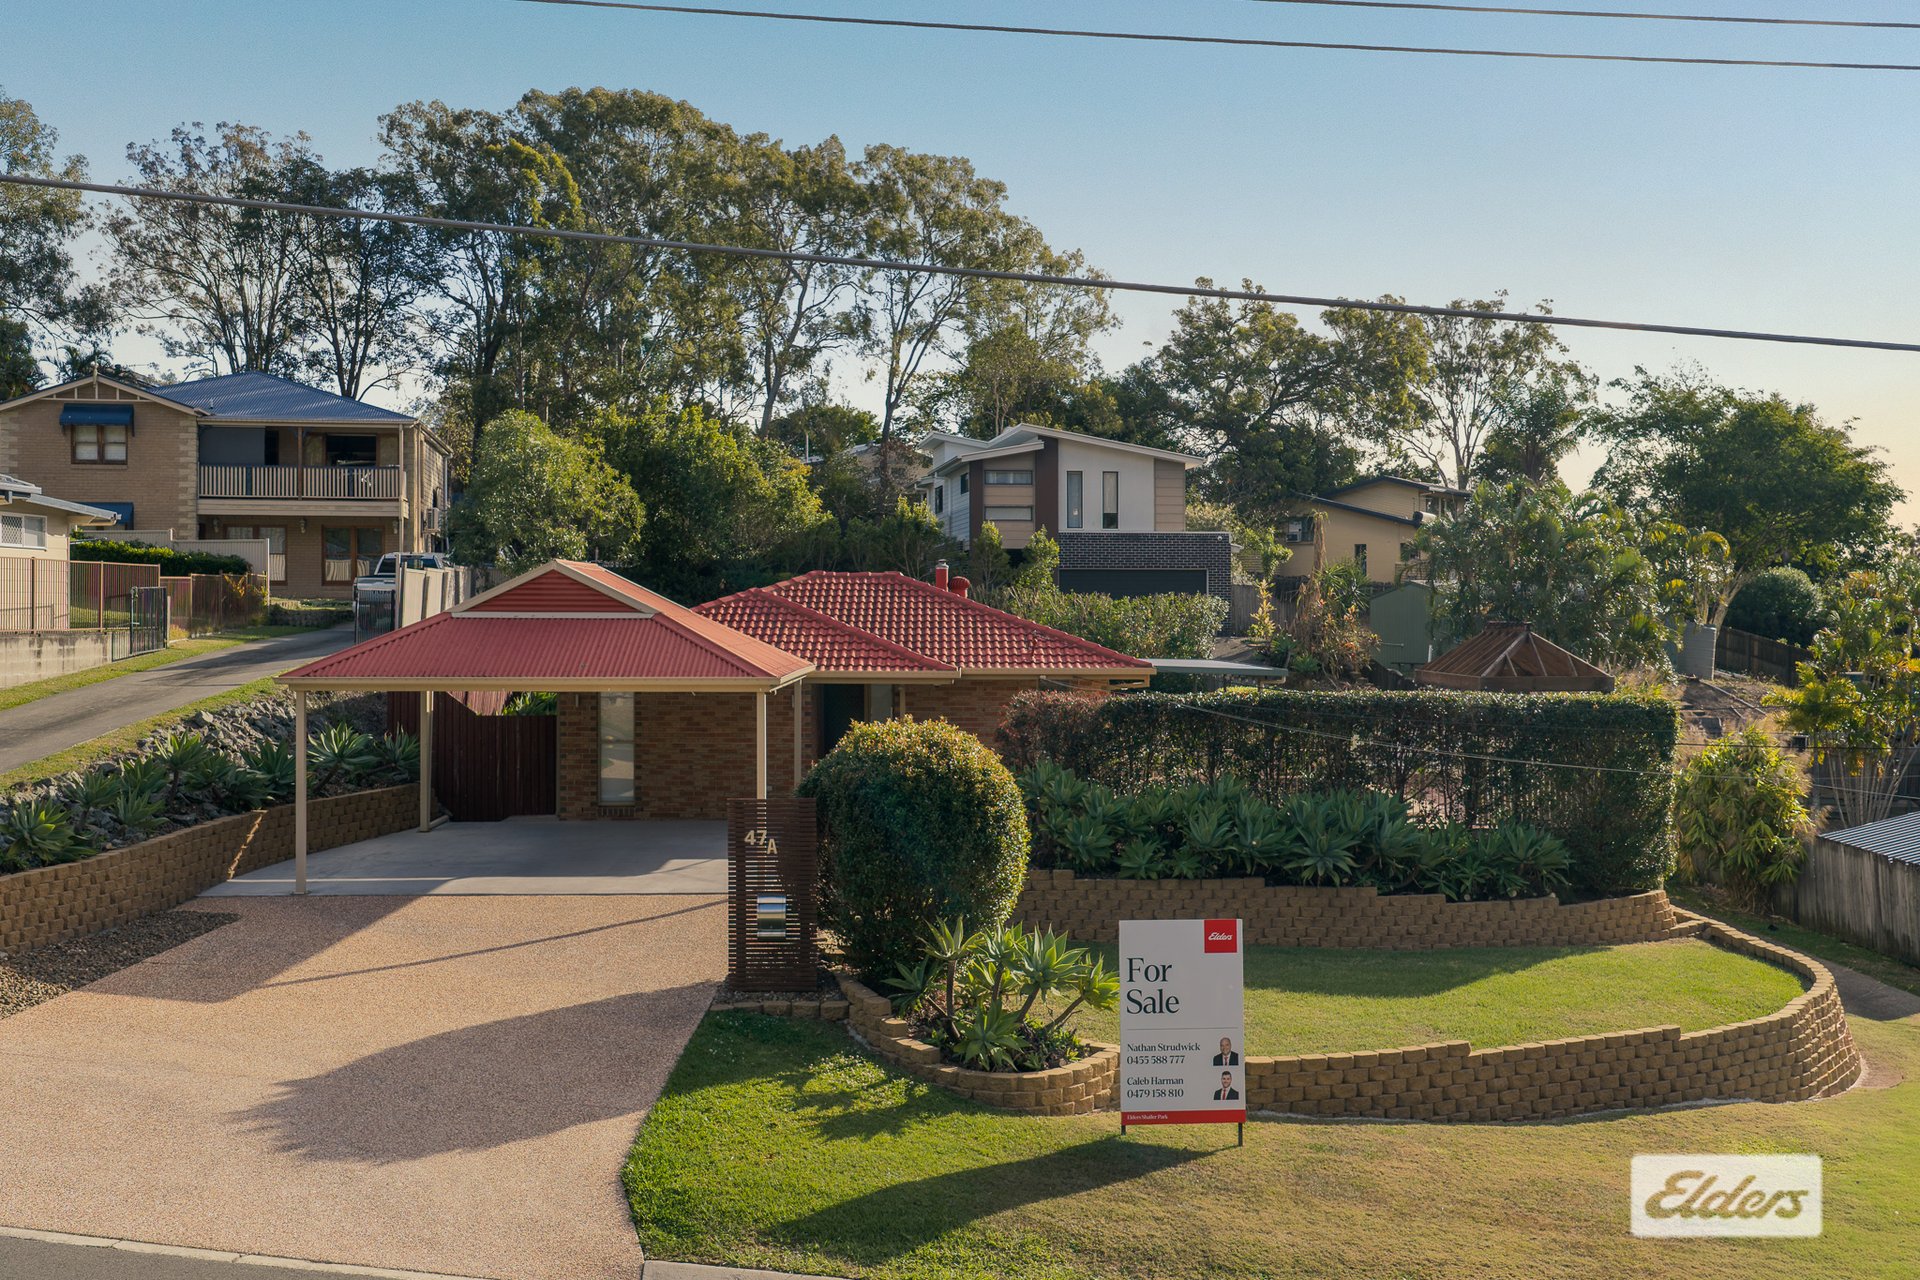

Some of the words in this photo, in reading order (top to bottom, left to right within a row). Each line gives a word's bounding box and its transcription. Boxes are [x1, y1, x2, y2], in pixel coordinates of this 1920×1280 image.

[744, 829, 778, 855] 47A
[1208, 932, 1232, 940] Elders
[1126, 957, 1173, 983] For
[1126, 988, 1180, 1014] Sale
[1127, 1043, 1156, 1052] Nathan
[1158, 1042, 1200, 1052] Strudwick
[1127, 1056, 1149, 1064] 0455
[1151, 1056, 1168, 1064] 588
[1169, 1055, 1185, 1064] 777
[1127, 1077, 1150, 1086] Caleb
[1151, 1077, 1184, 1085] Harman
[1127, 1090, 1150, 1098] 0479
[1152, 1089, 1166, 1098] 158
[1168, 1088, 1184, 1098] 810
